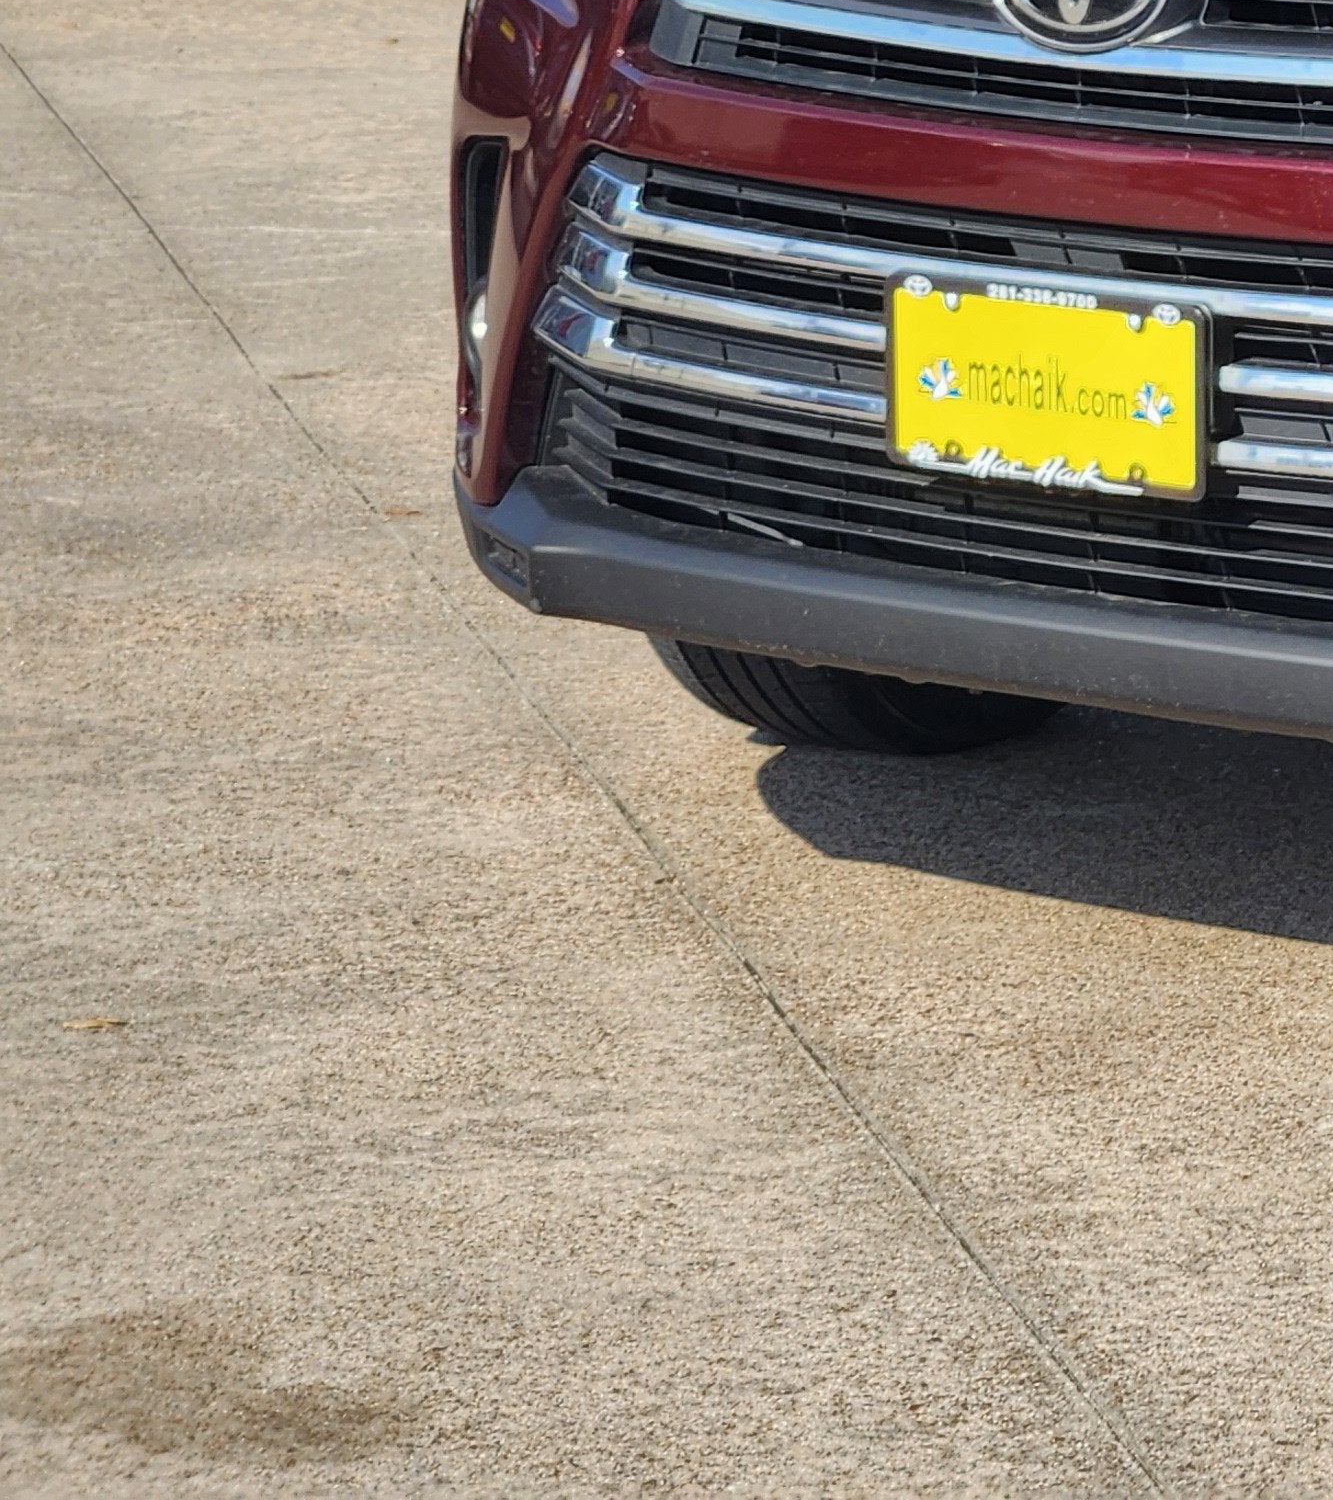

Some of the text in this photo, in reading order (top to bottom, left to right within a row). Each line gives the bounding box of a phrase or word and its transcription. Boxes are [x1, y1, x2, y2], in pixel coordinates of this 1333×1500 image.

[967, 353, 1128, 420] machaik.com
[967, 447, 1103, 489] Mac Haik
